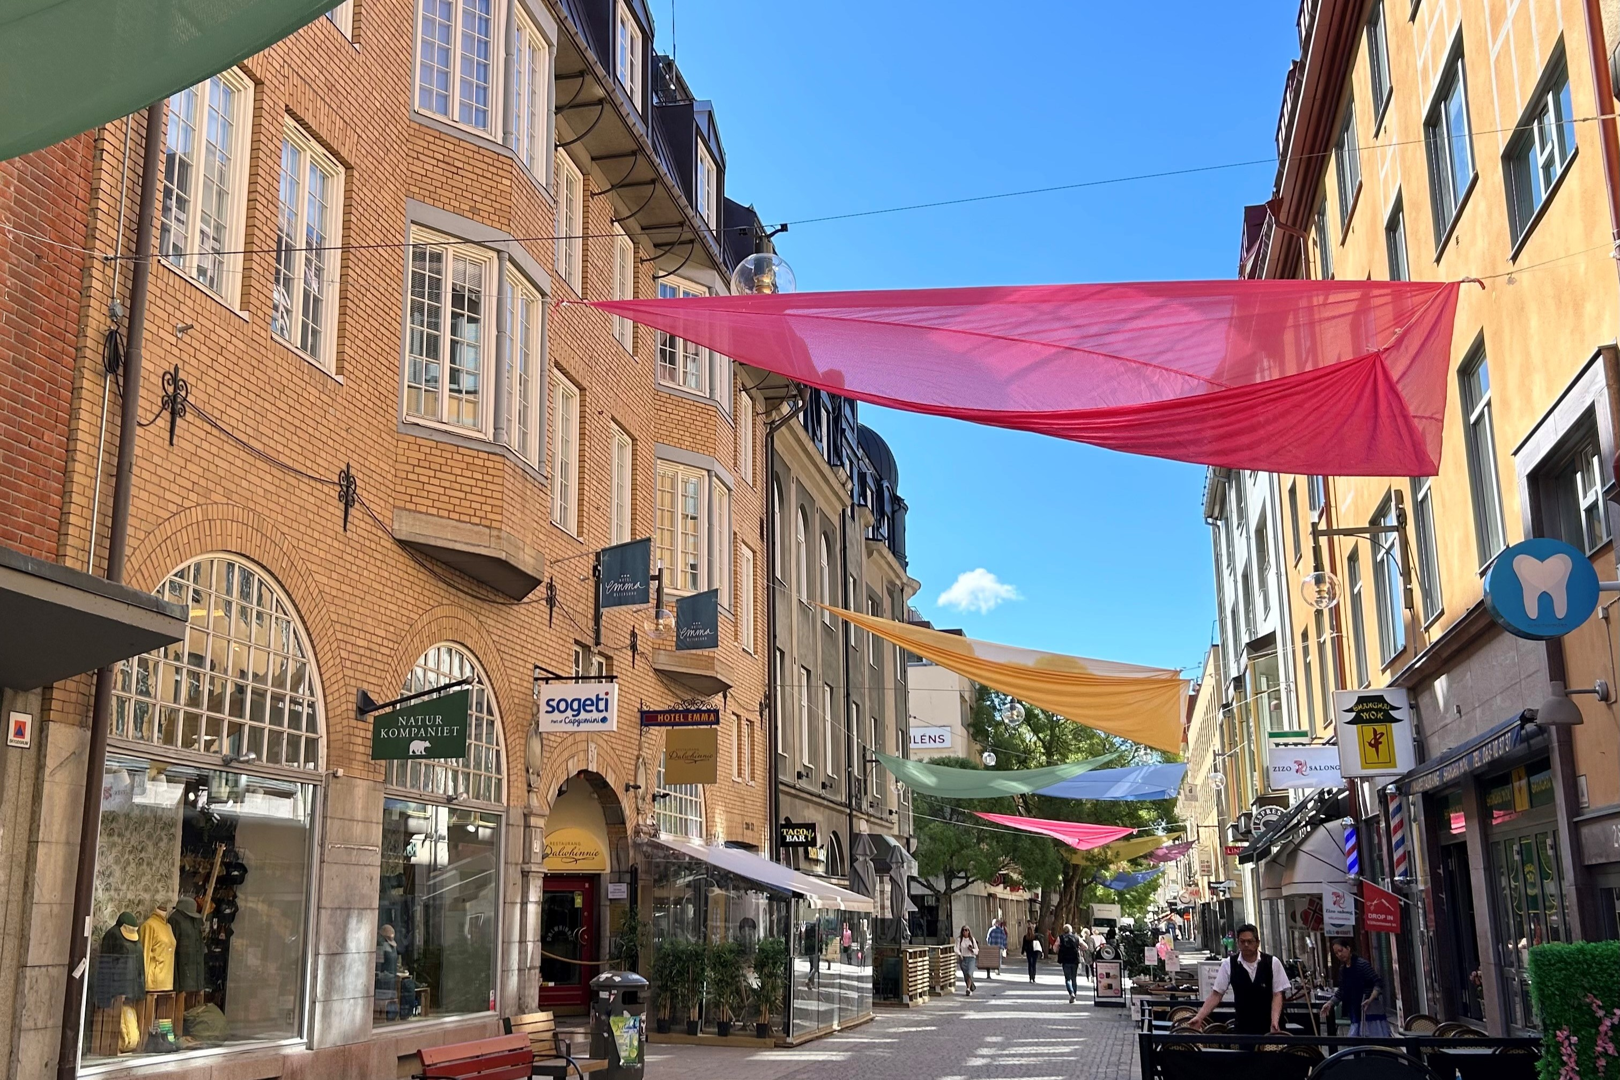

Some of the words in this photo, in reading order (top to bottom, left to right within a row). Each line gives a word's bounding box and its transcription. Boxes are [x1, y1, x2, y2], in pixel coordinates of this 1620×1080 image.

[605, 580, 646, 594] emma
[680, 626, 715, 639] emma
[544, 691, 610, 718] sogeti
[398, 715, 443, 726] NATUR
[657, 713, 685, 722] HOTEL
[688, 713, 715, 722] EMMA
[1360, 710, 1384, 720] WOK
[380, 726, 460, 738] KOMPANIET
[909, 733, 945, 744] LÉNS
[1272, 765, 1292, 773] ZIZO
[1254, 808, 1283, 824] ESPRES
[781, 828, 807, 836] TACO
